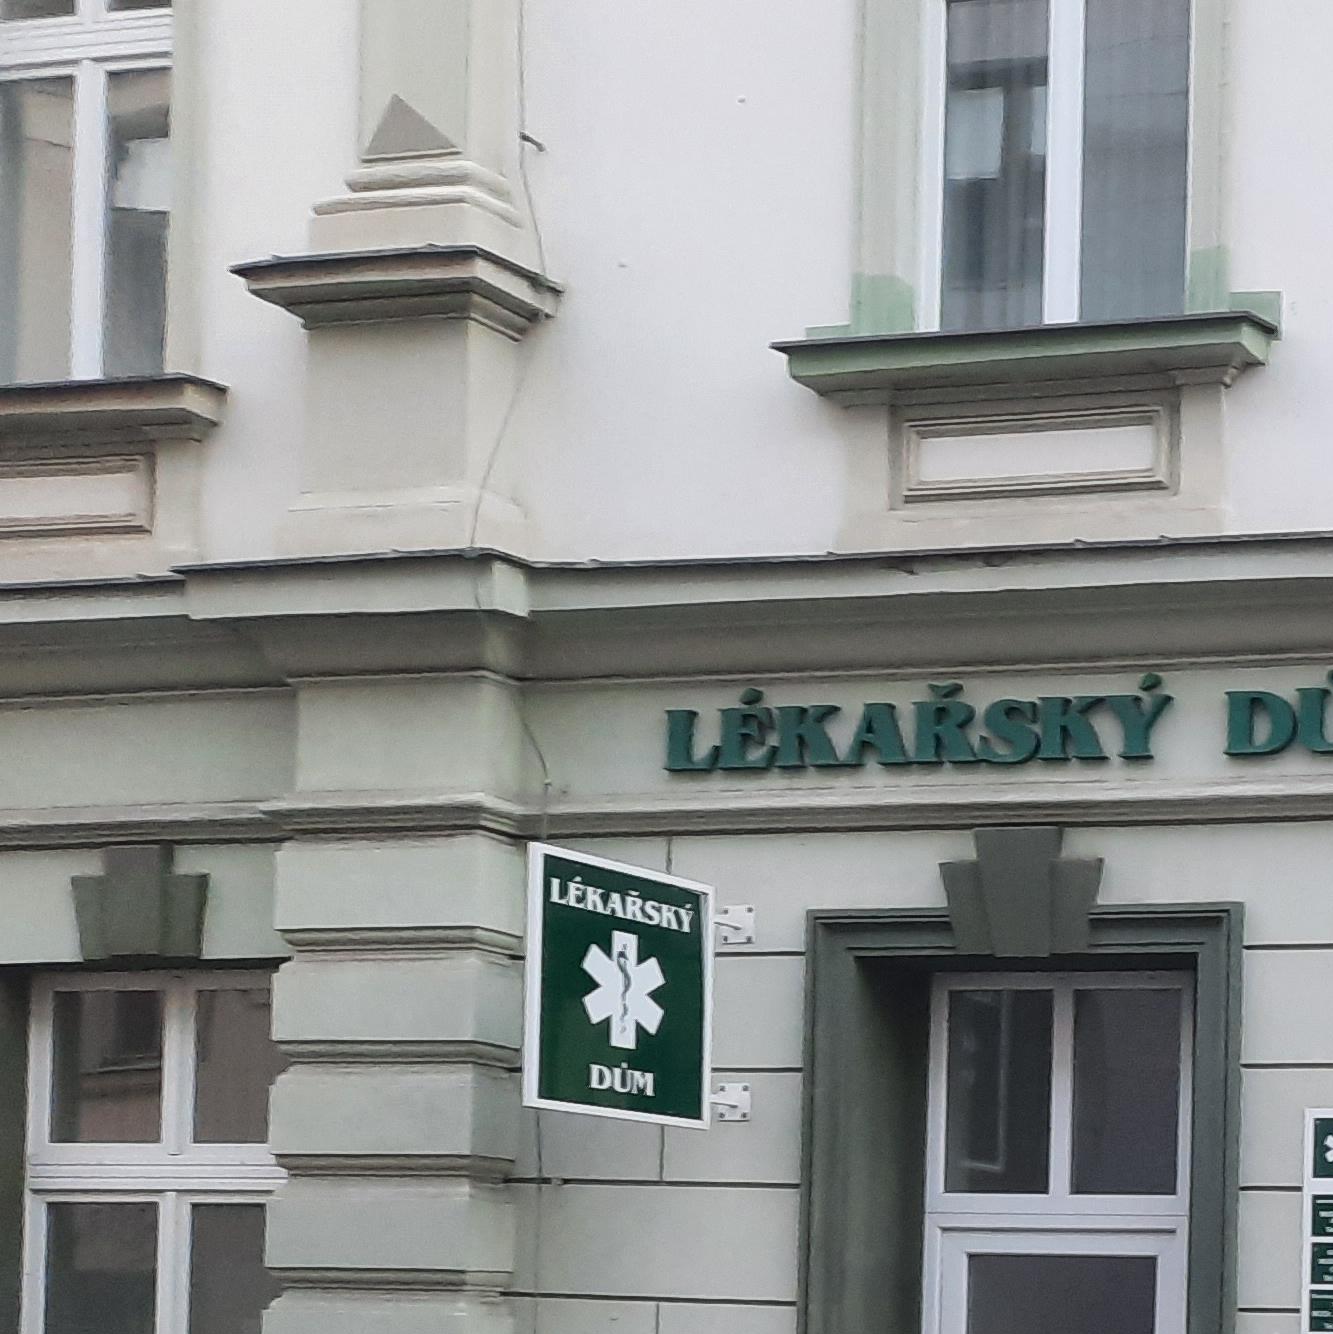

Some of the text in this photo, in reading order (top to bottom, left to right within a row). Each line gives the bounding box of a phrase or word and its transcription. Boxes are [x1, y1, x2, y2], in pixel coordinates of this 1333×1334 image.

[664, 672, 1175, 772] LÉKAŘSKÝ
[549, 876, 694, 934] LÉKAŘSKÝ
[588, 1062, 656, 1098] DŮM
